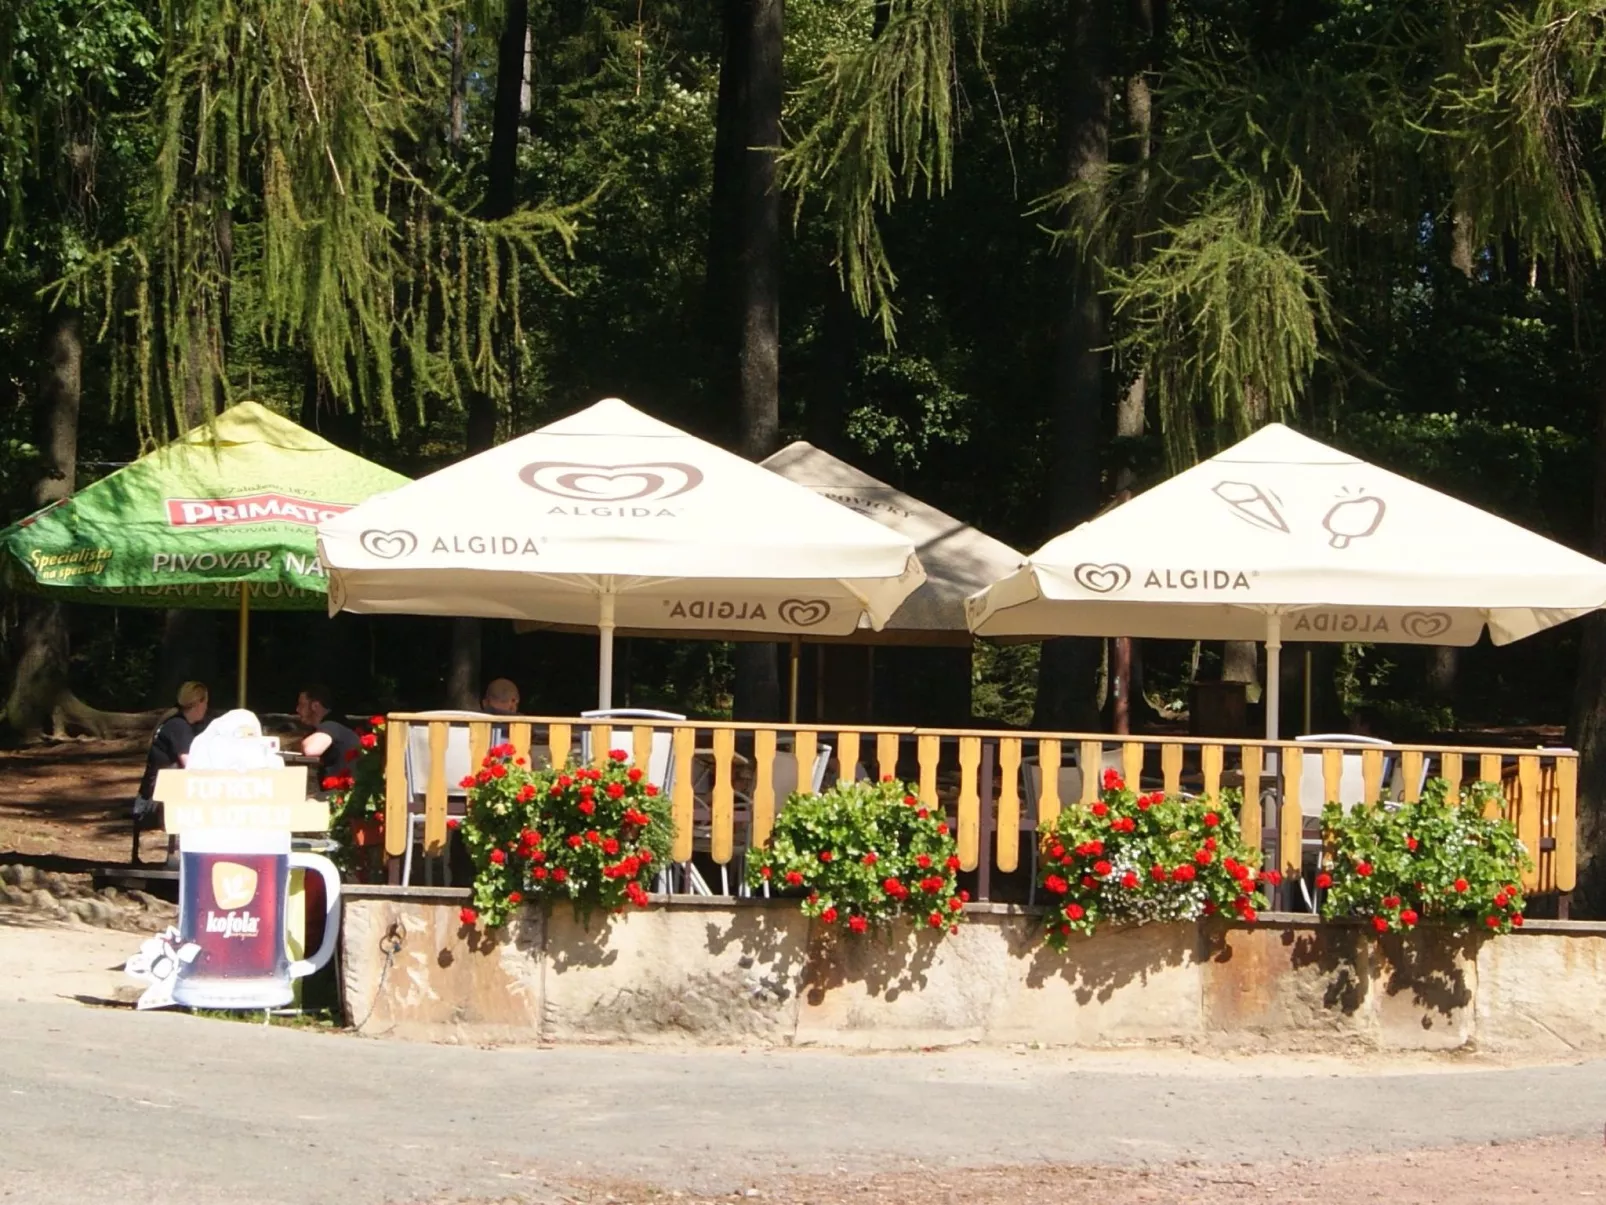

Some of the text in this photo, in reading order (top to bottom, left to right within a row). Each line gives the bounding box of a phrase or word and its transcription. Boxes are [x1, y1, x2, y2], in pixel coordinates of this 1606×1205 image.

[181, 499, 338, 525] PRIMATO
[152, 550, 328, 578] PIVOVAR NA
[205, 910, 259, 939] kofola
